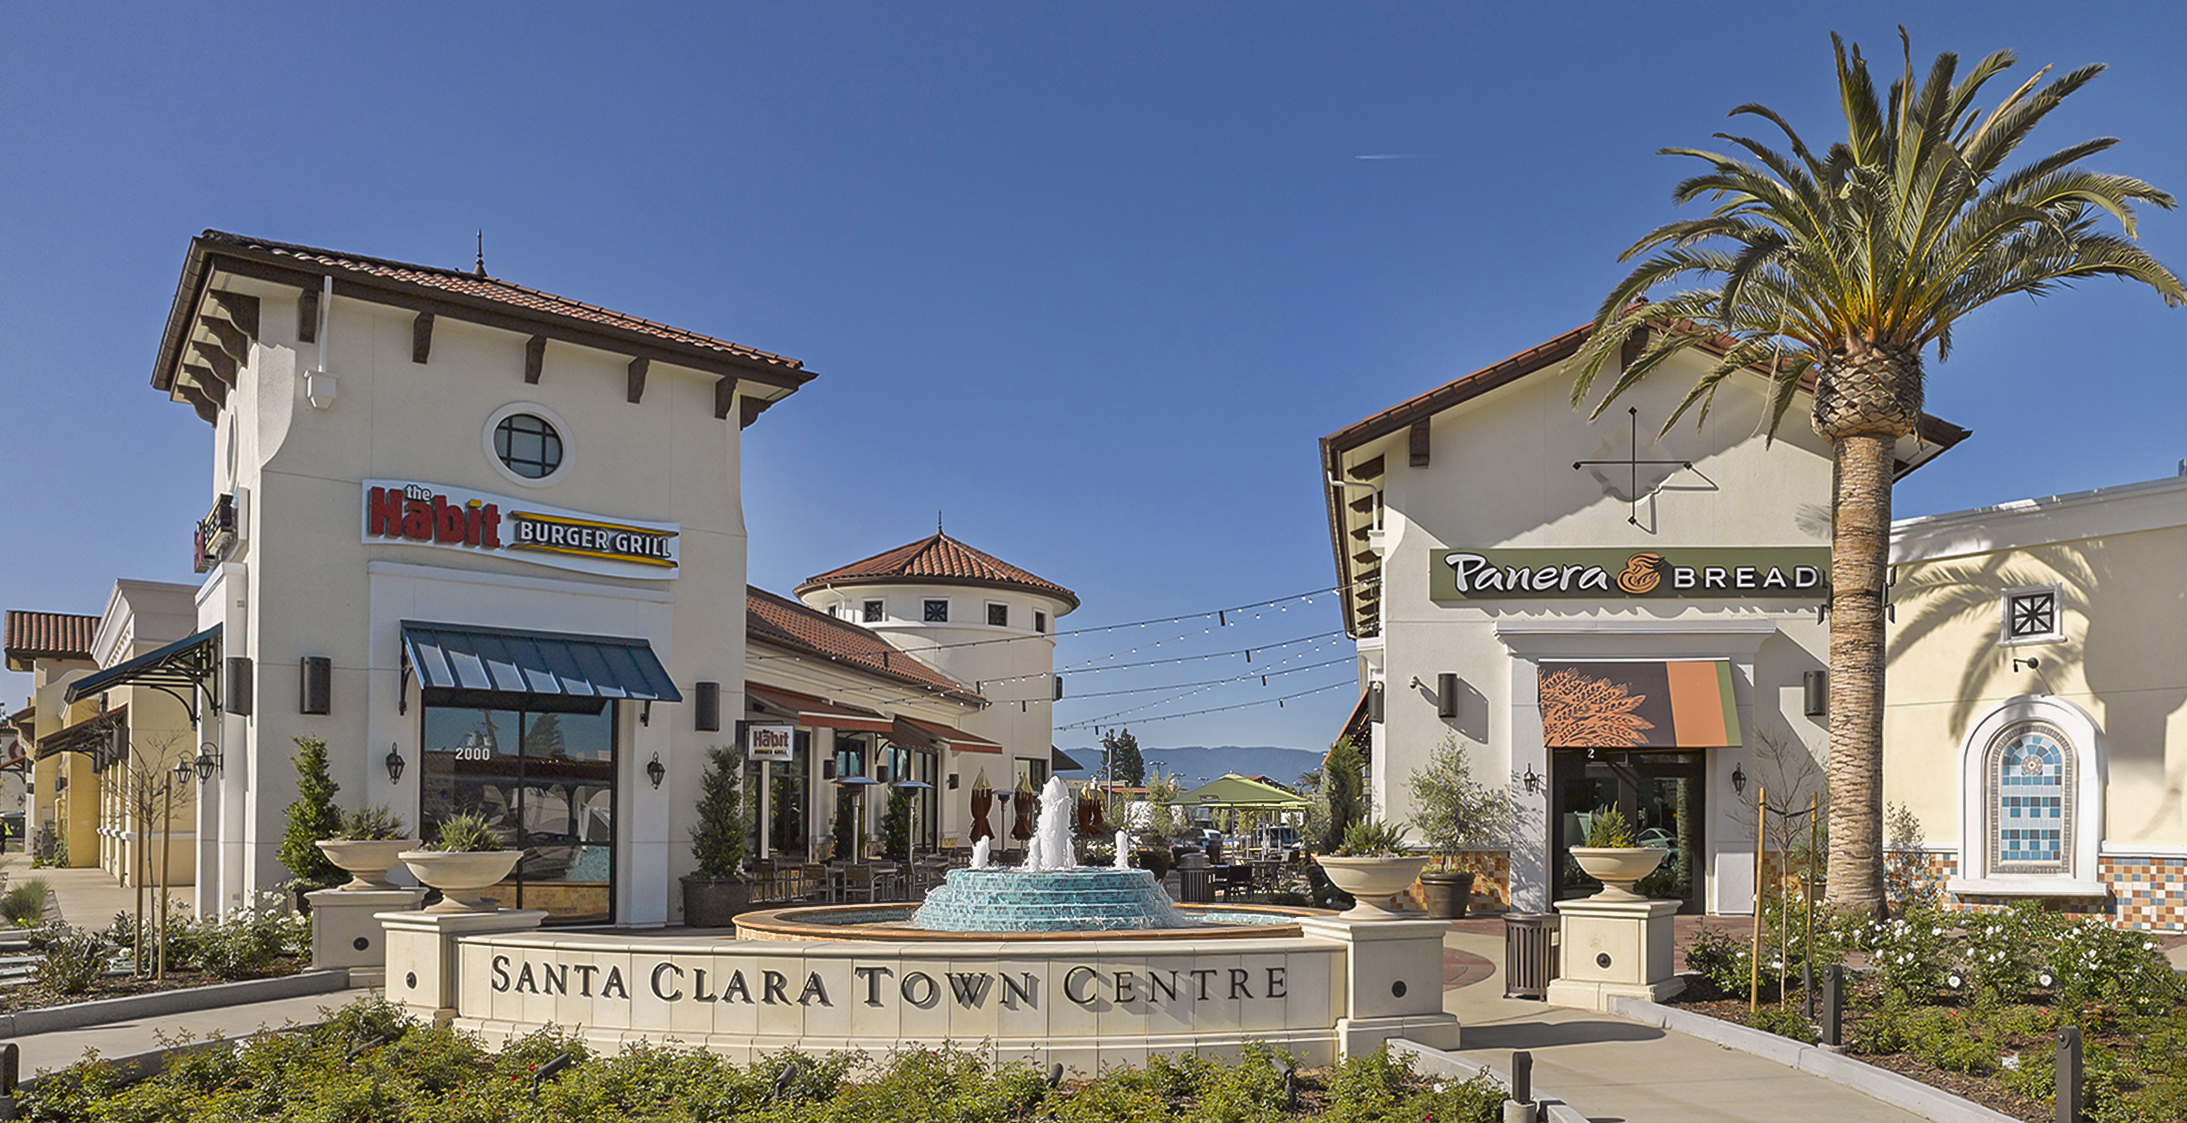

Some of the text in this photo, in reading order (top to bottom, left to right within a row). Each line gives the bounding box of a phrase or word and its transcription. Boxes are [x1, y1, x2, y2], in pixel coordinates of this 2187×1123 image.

[406, 485, 431, 501] the
[367, 486, 671, 558] Habit BURGER GRILL
[1444, 552, 1818, 592] Panera BREAD
[753, 730, 789, 748] Habit
[455, 747, 490, 760] 2000
[1587, 747, 1595, 759] 2
[490, 954, 1288, 1008] SANTA CLARA TOWN CENTRE
